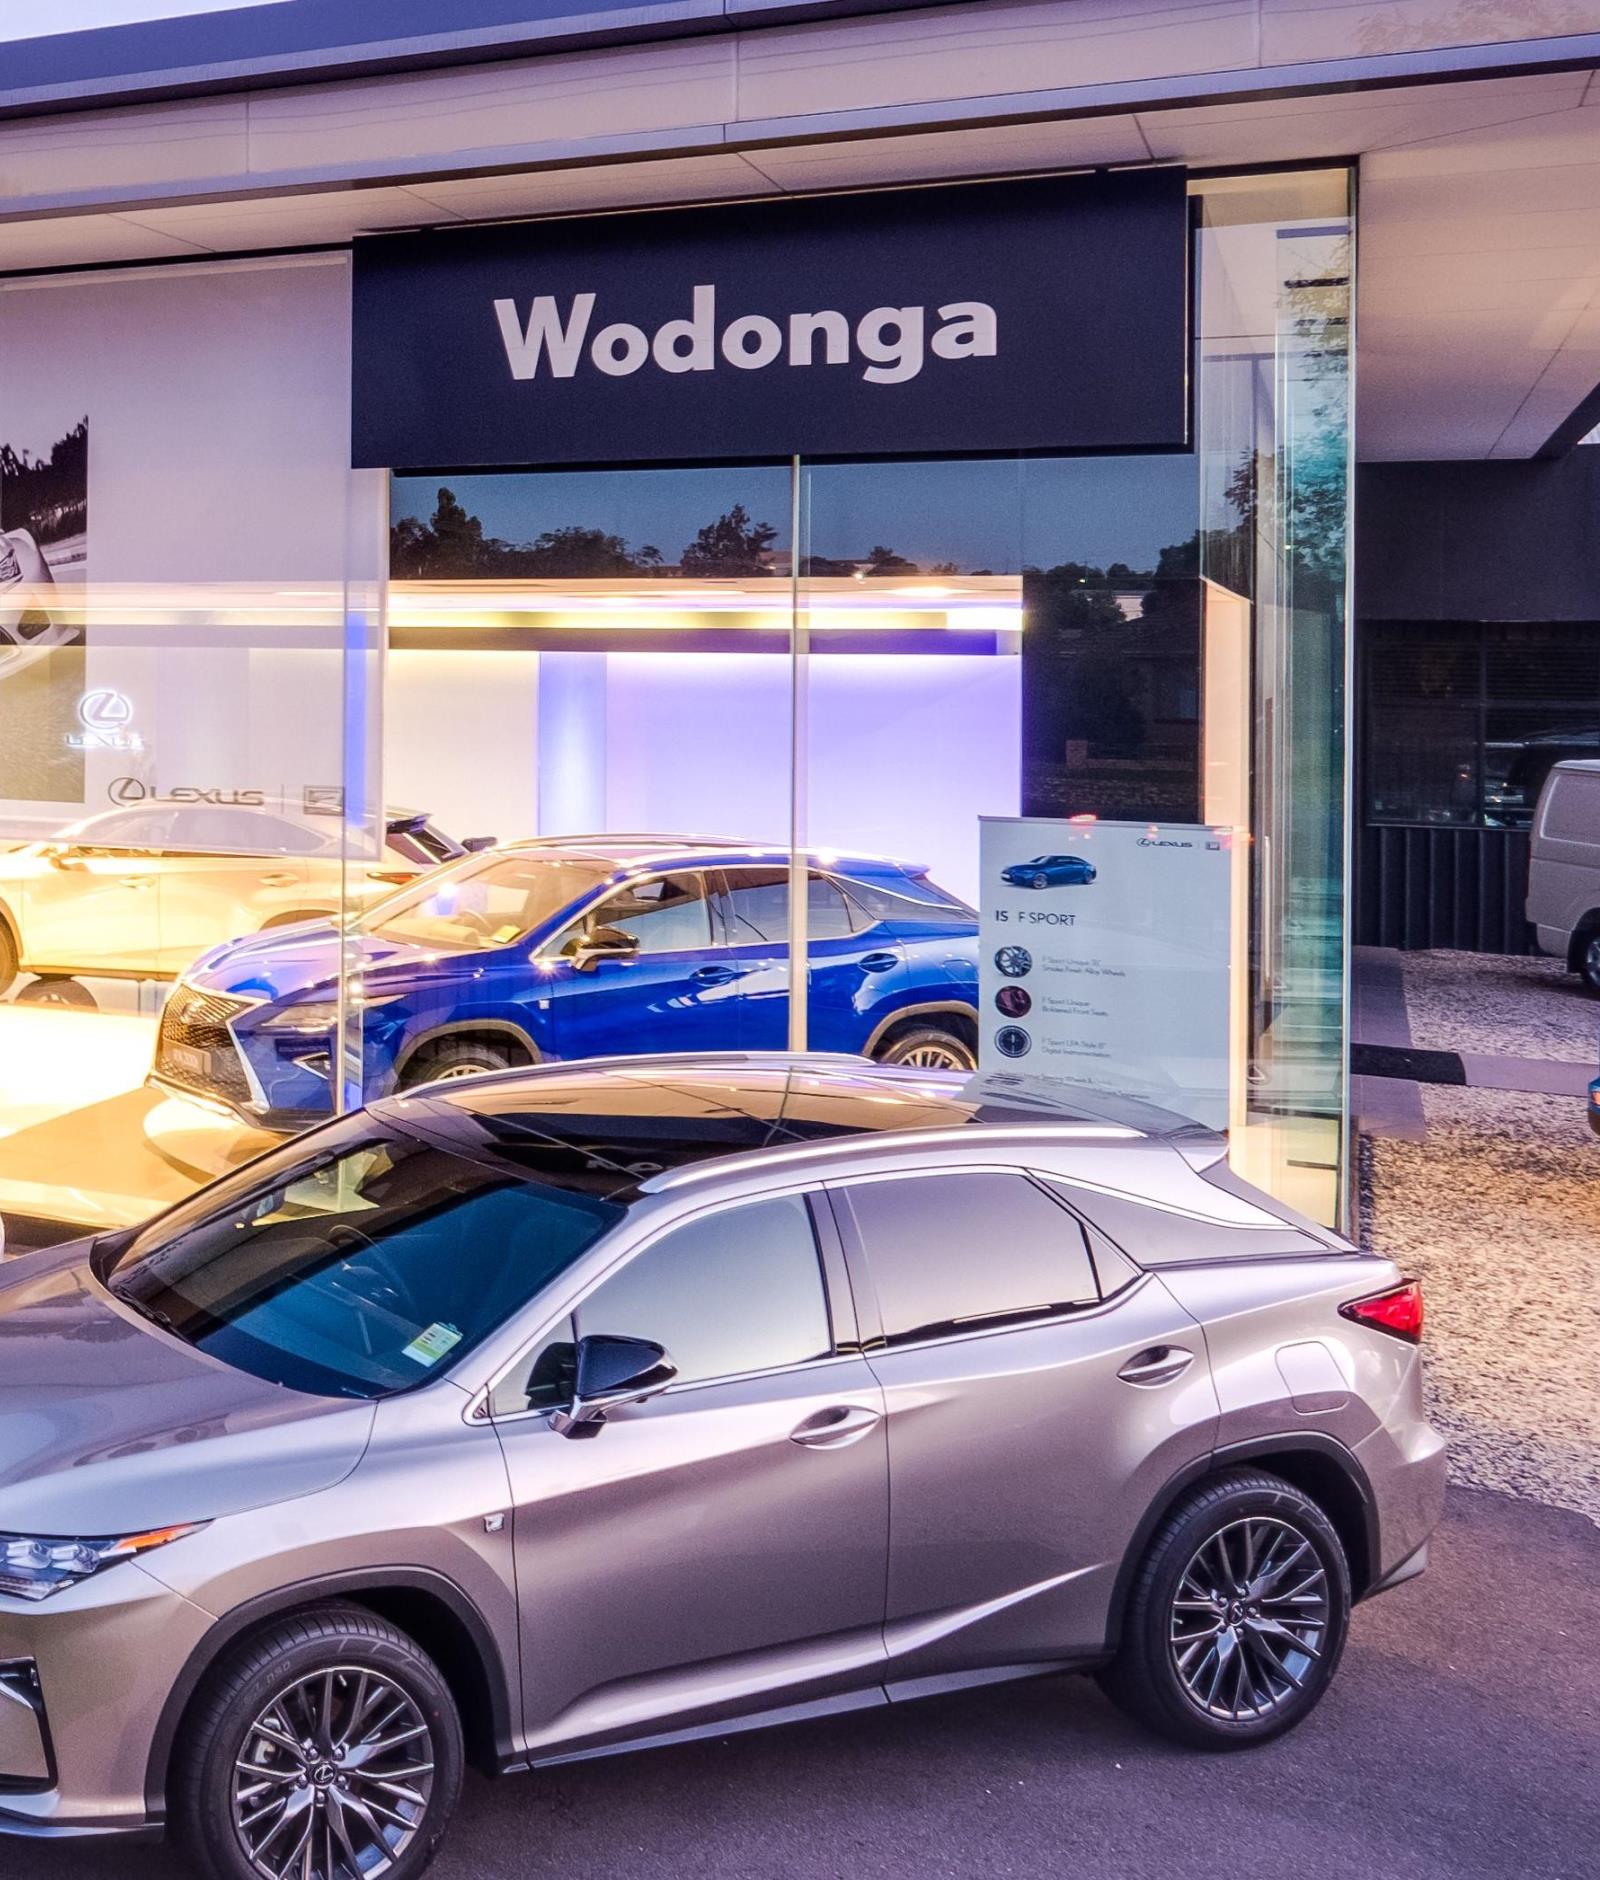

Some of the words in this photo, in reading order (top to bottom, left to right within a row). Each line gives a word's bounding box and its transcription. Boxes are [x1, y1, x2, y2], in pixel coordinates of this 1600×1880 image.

[493, 284, 998, 385] Wodonga
[150, 786, 264, 806] LEXUS
[995, 910, 1009, 922] IS
[1018, 911, 1026, 923] F
[1028, 912, 1076, 927] SPORT
